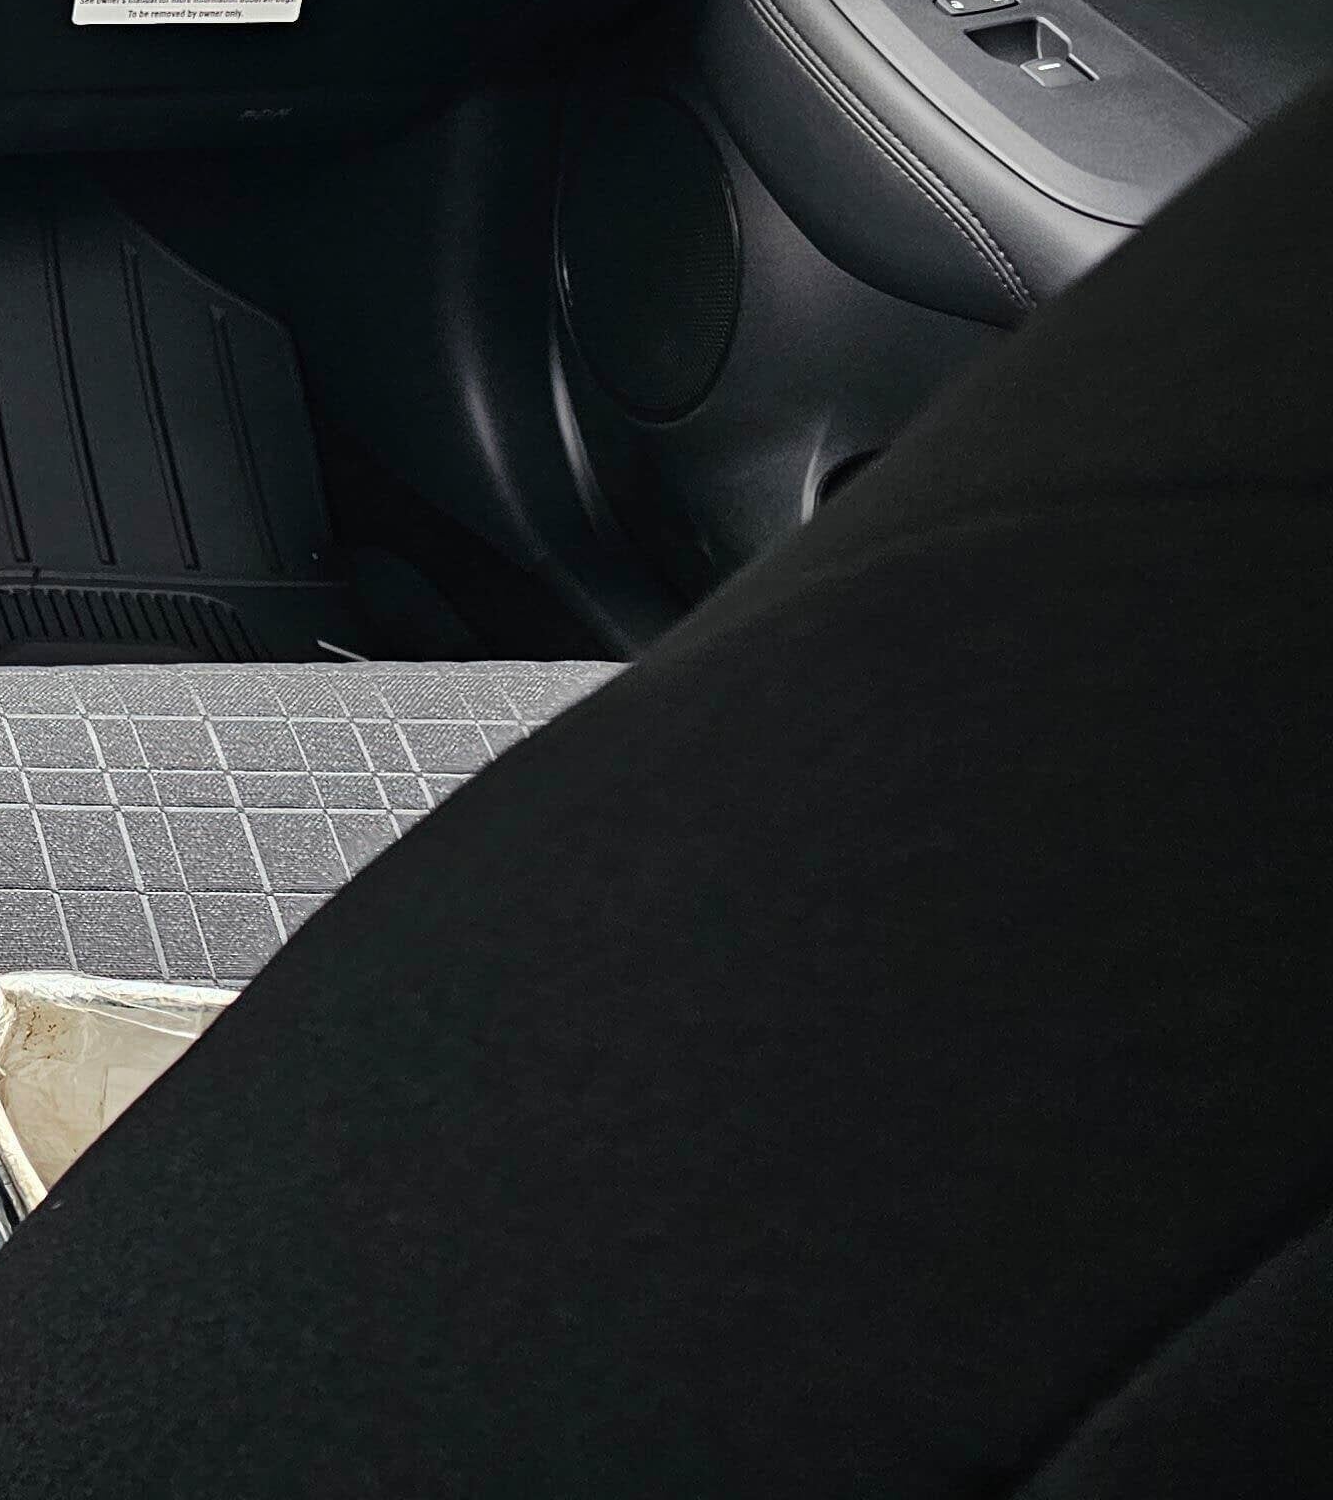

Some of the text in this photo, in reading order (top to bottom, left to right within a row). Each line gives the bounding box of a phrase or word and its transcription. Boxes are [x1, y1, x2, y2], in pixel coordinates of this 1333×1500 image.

[127, 10, 137, 18] To
[138, 10, 149, 18] be
[150, 10, 186, 18] removed
[187, 10, 197, 19] by
[198, 10, 224, 18] owner
